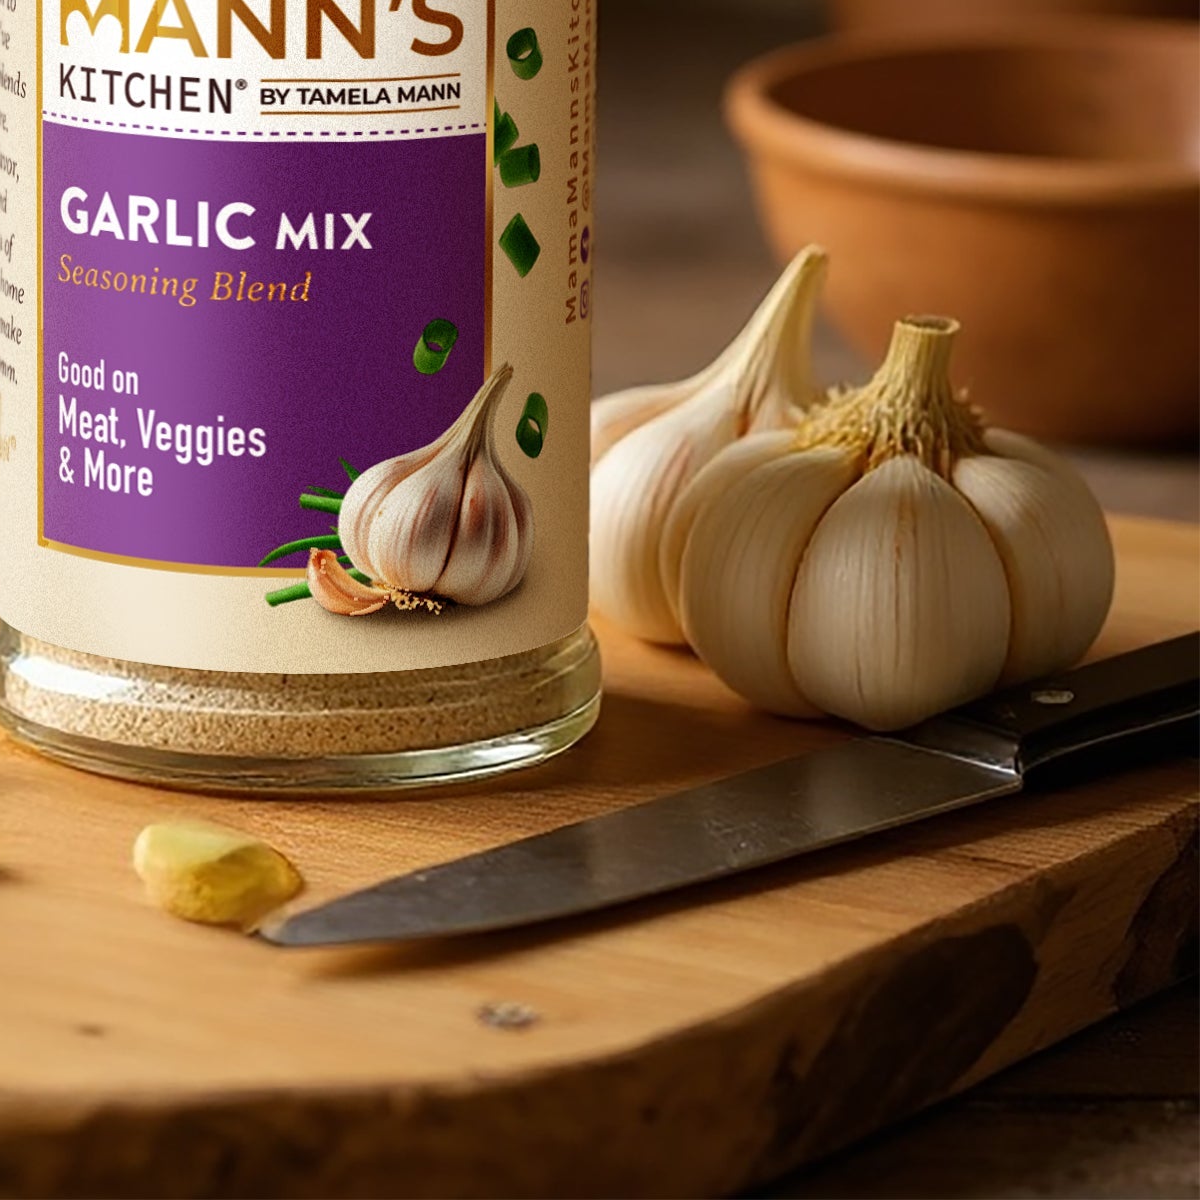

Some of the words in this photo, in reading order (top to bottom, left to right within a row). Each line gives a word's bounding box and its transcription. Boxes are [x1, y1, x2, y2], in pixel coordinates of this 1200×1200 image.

[260, 87, 291, 105] BY
[296, 87, 392, 105] TAMELA
[397, 81, 461, 104] MANN
[59, 186, 257, 250] GARLIC
[274, 212, 374, 251] MIX
[0, 270, 25, 305] home
[58, 253, 199, 308] Seasoning
[210, 270, 313, 303] Blend
[0, 314, 22, 345] make
[57, 350, 105, 393] Good
[112, 367, 139, 396] on
[58, 394, 127, 450] Meat,
[136, 407, 268, 467] Veggies
[58, 446, 75, 485] &
[83, 454, 154, 497] More
